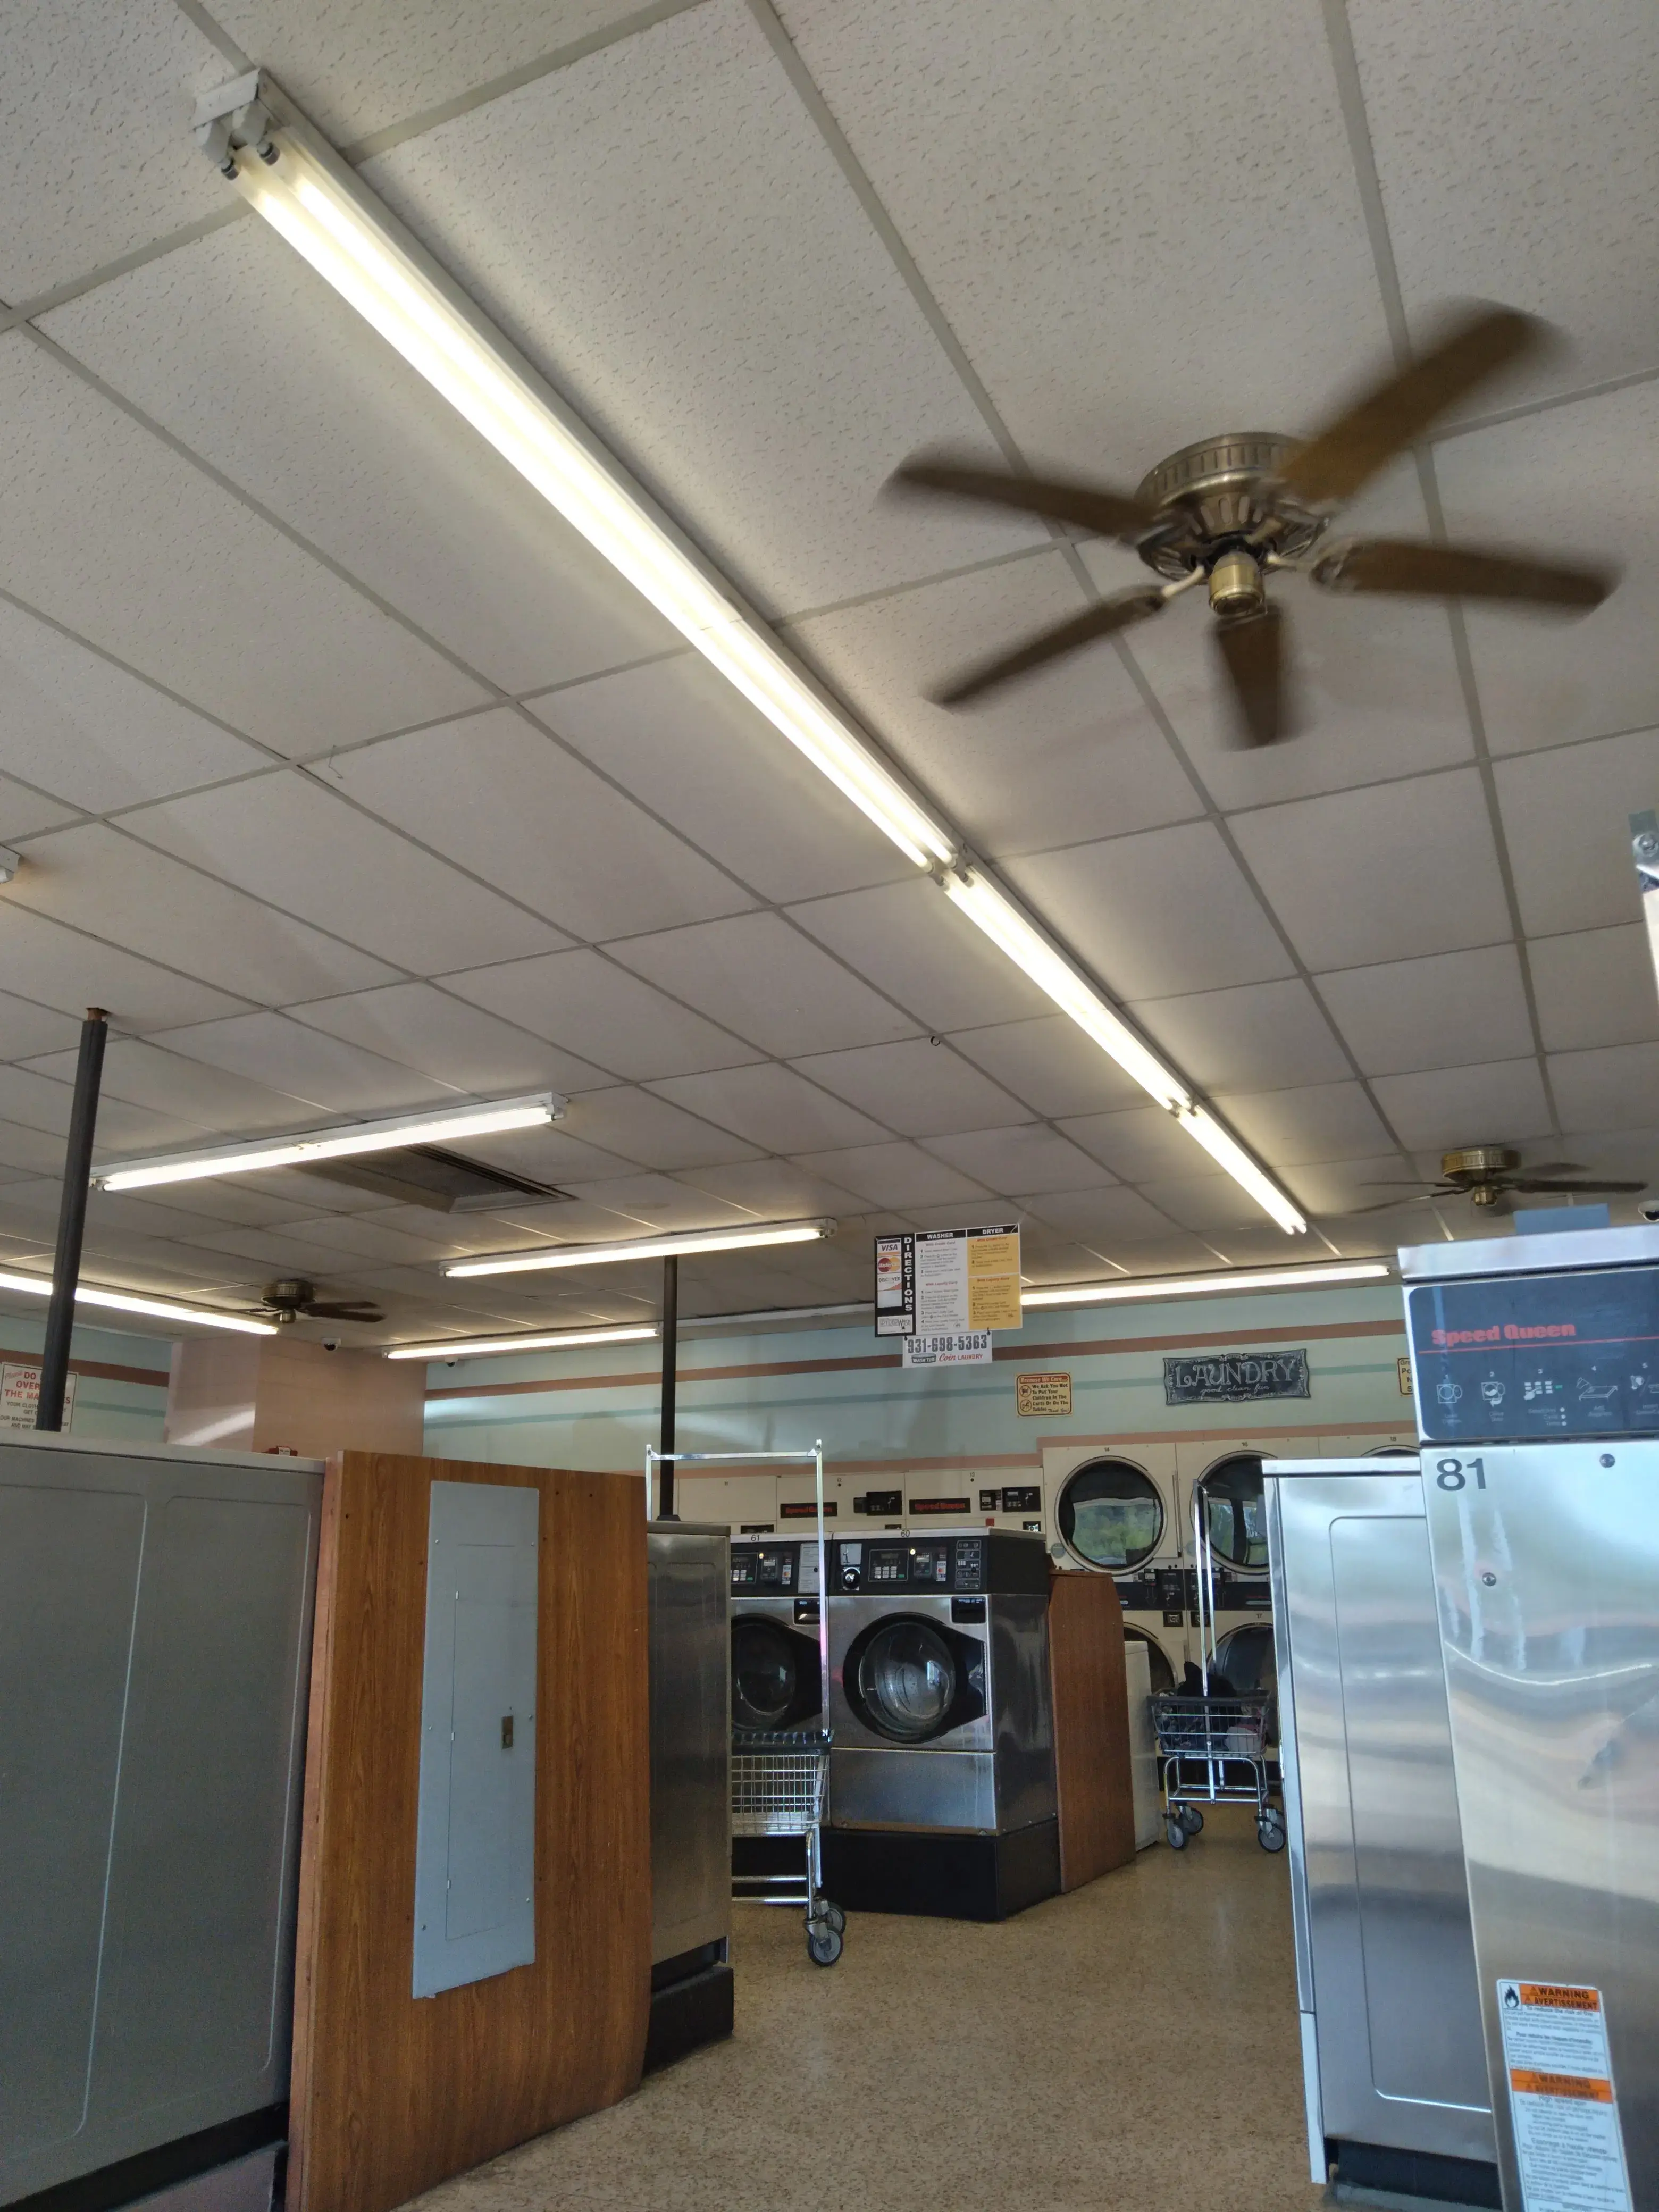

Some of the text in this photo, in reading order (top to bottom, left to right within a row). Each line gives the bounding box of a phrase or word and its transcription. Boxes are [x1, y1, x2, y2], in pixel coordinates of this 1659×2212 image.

[904, 1237, 913, 1311] DIRECTIONS
[1431, 1324, 1576, 1347] Speed Queen
[907, 1334, 987, 1353] 931-698-5363
[939, 1353, 956, 1362] Coin
[1175, 1359, 1296, 1388] LAUNDRY
[16, 1381, 40, 1391] OVER
[1200, 1386, 1222, 1396] good
[1254, 1383, 1270, 1393] fun
[5, 1389, 22, 1398] THE
[1436, 1457, 1486, 1491] 81
[915, 1502, 940, 1511] Speed
[1538, 1987, 1589, 2000] WARNING
[1534, 1997, 1598, 2009] AVERTISSEMENT
[1538, 2074, 1591, 2089] WARNING
